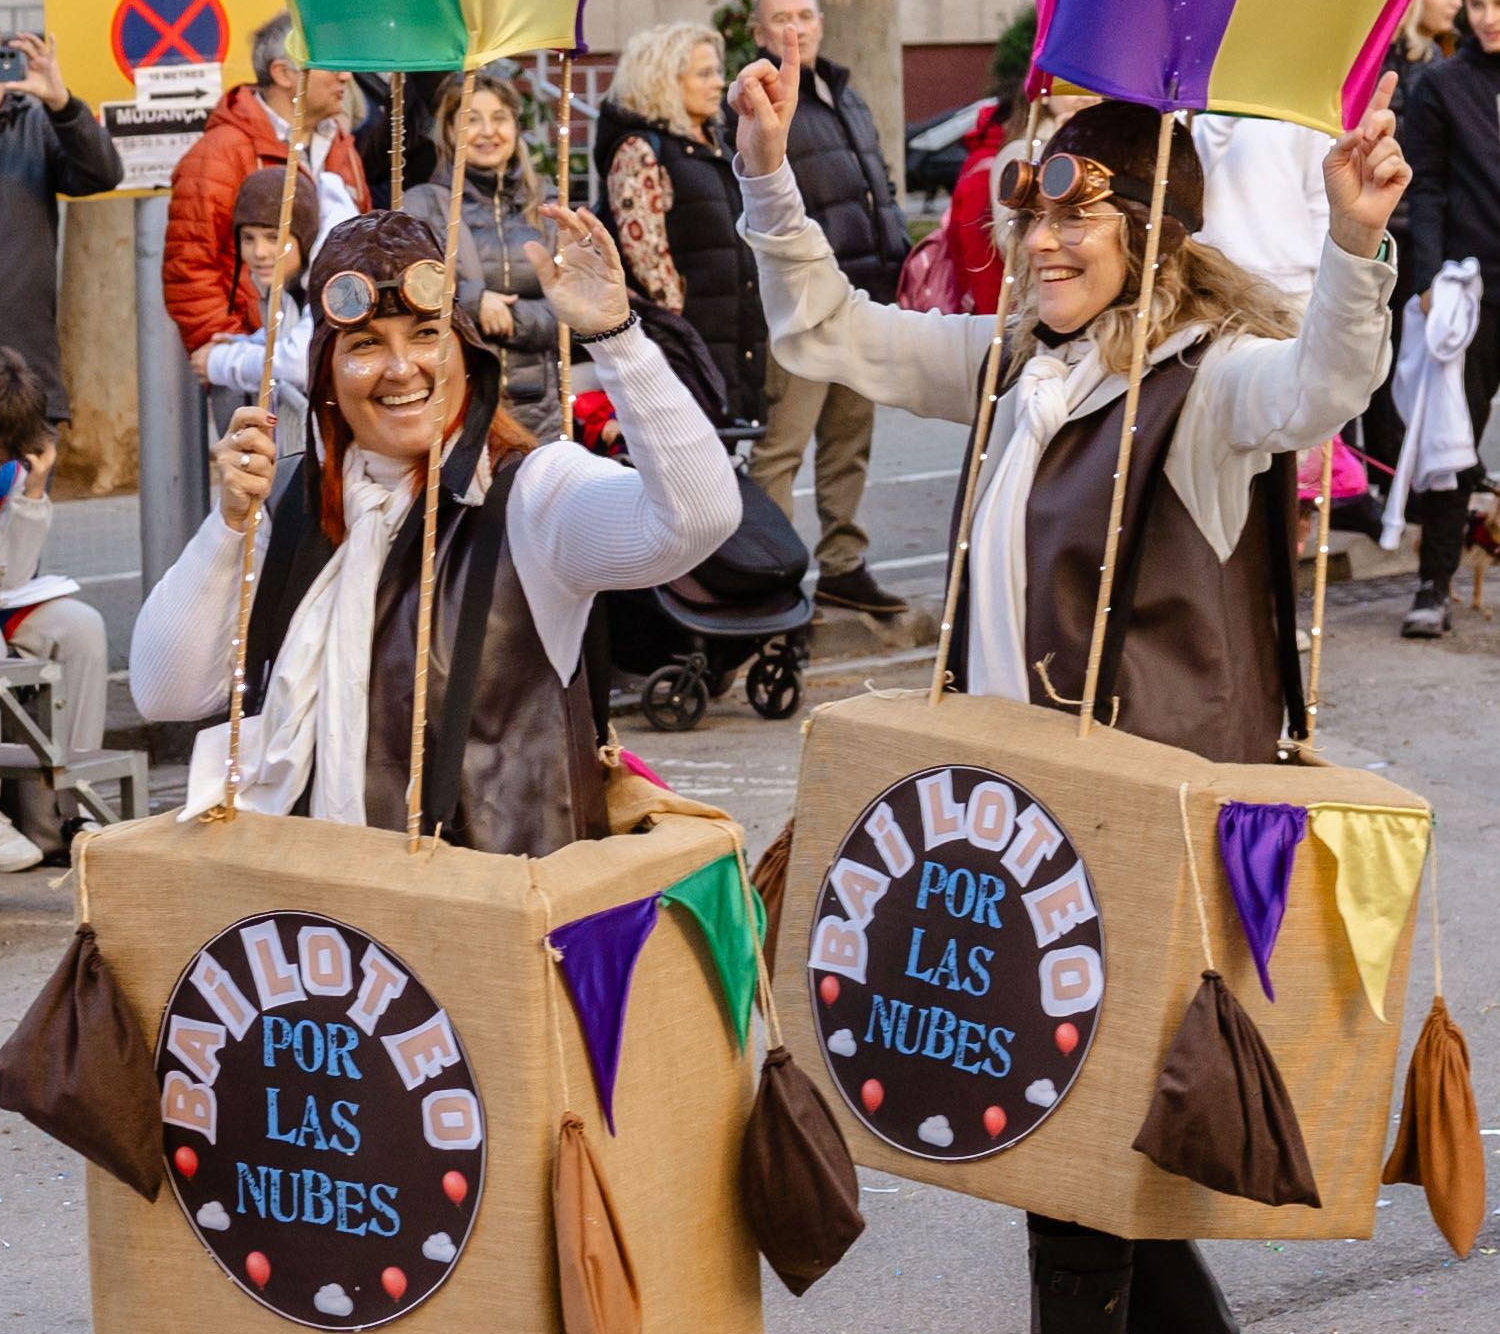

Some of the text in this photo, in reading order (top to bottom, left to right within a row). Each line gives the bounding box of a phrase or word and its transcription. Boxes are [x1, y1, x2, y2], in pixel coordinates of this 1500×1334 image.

[915, 861, 1007, 928] POR
[904, 927, 995, 996] LAS
[262, 1015, 362, 1080] POR
[864, 994, 1016, 1078] NUBES
[265, 1087, 361, 1155] LAS
[235, 1162, 401, 1237] NUBES
